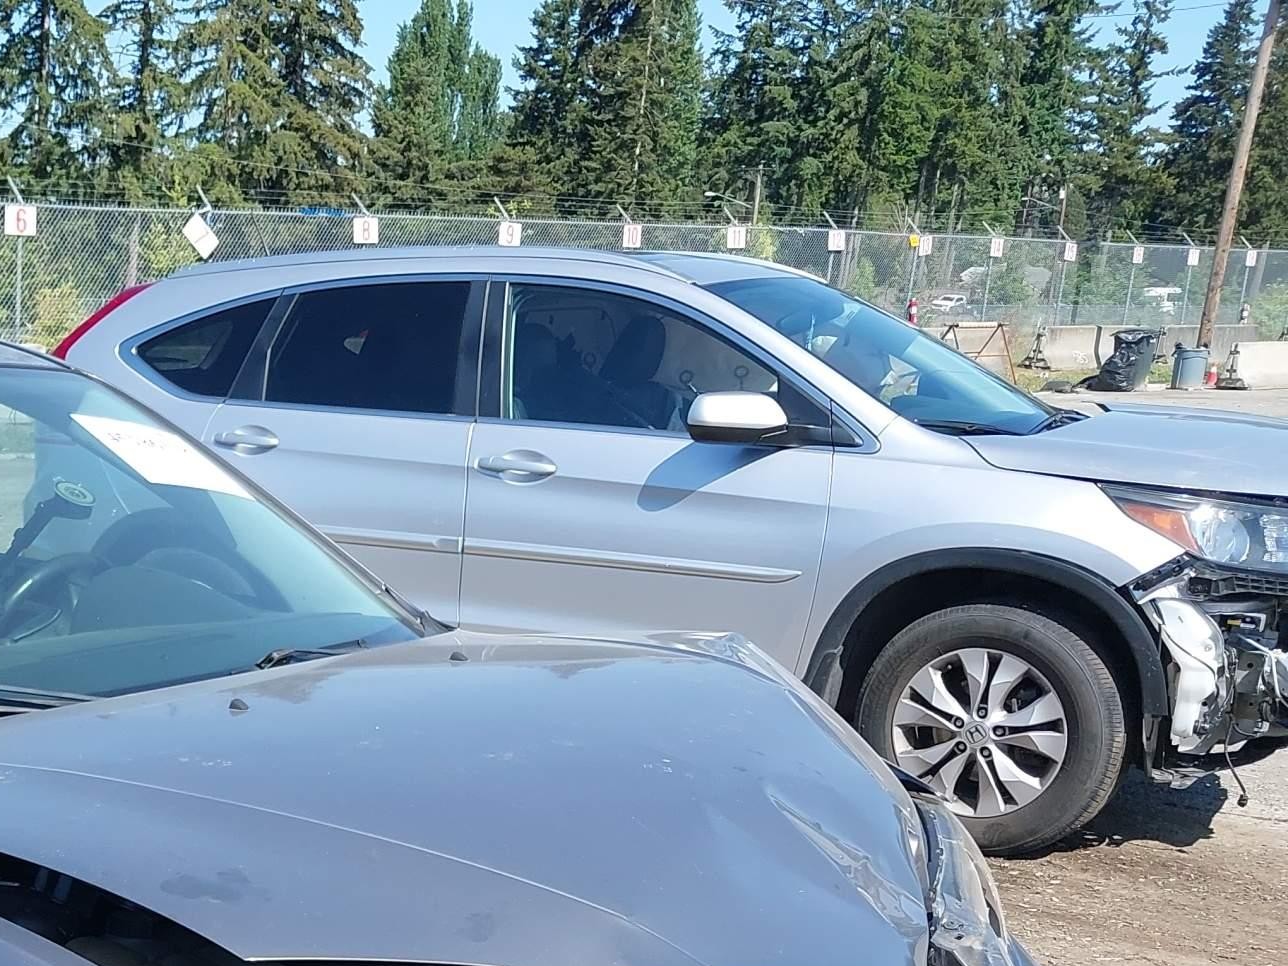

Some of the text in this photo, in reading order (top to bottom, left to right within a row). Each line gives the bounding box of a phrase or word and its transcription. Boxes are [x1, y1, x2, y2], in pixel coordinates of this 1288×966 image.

[16, 208, 27, 234] 6
[362, 220, 371, 241] 8
[506, 224, 515, 244] 9
[627, 227, 638, 246] 10
[733, 229, 742, 246] 11
[832, 232, 842, 249] 12
